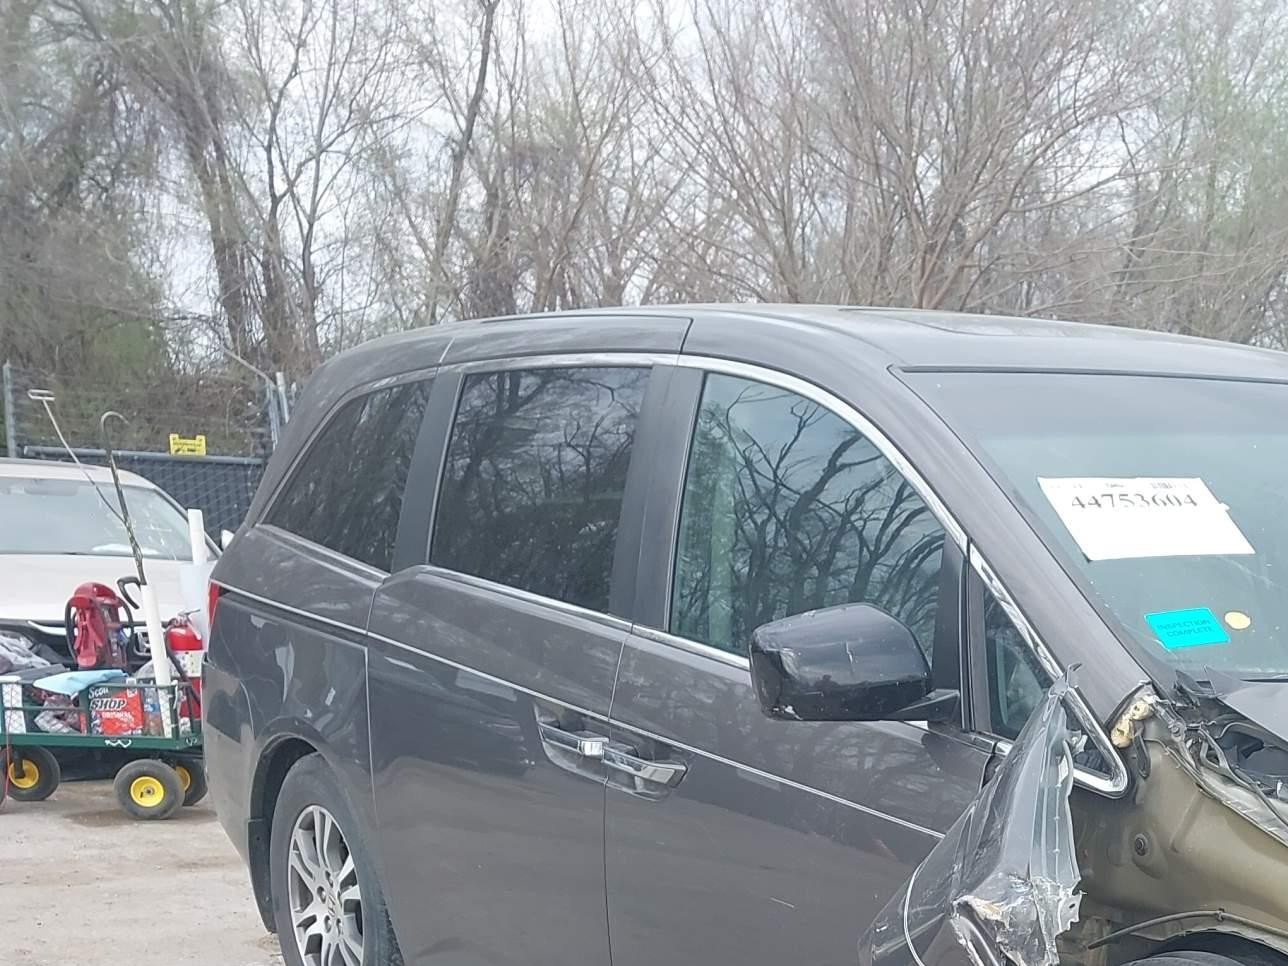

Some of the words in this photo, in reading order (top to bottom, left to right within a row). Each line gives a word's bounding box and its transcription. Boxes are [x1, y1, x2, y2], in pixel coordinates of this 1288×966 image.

[1071, 493, 1198, 509] 44753604
[1156, 618, 1212, 631] INSPECTION
[1166, 626, 1215, 638] COMPLETE
[89, 697, 127, 711] SHOP
